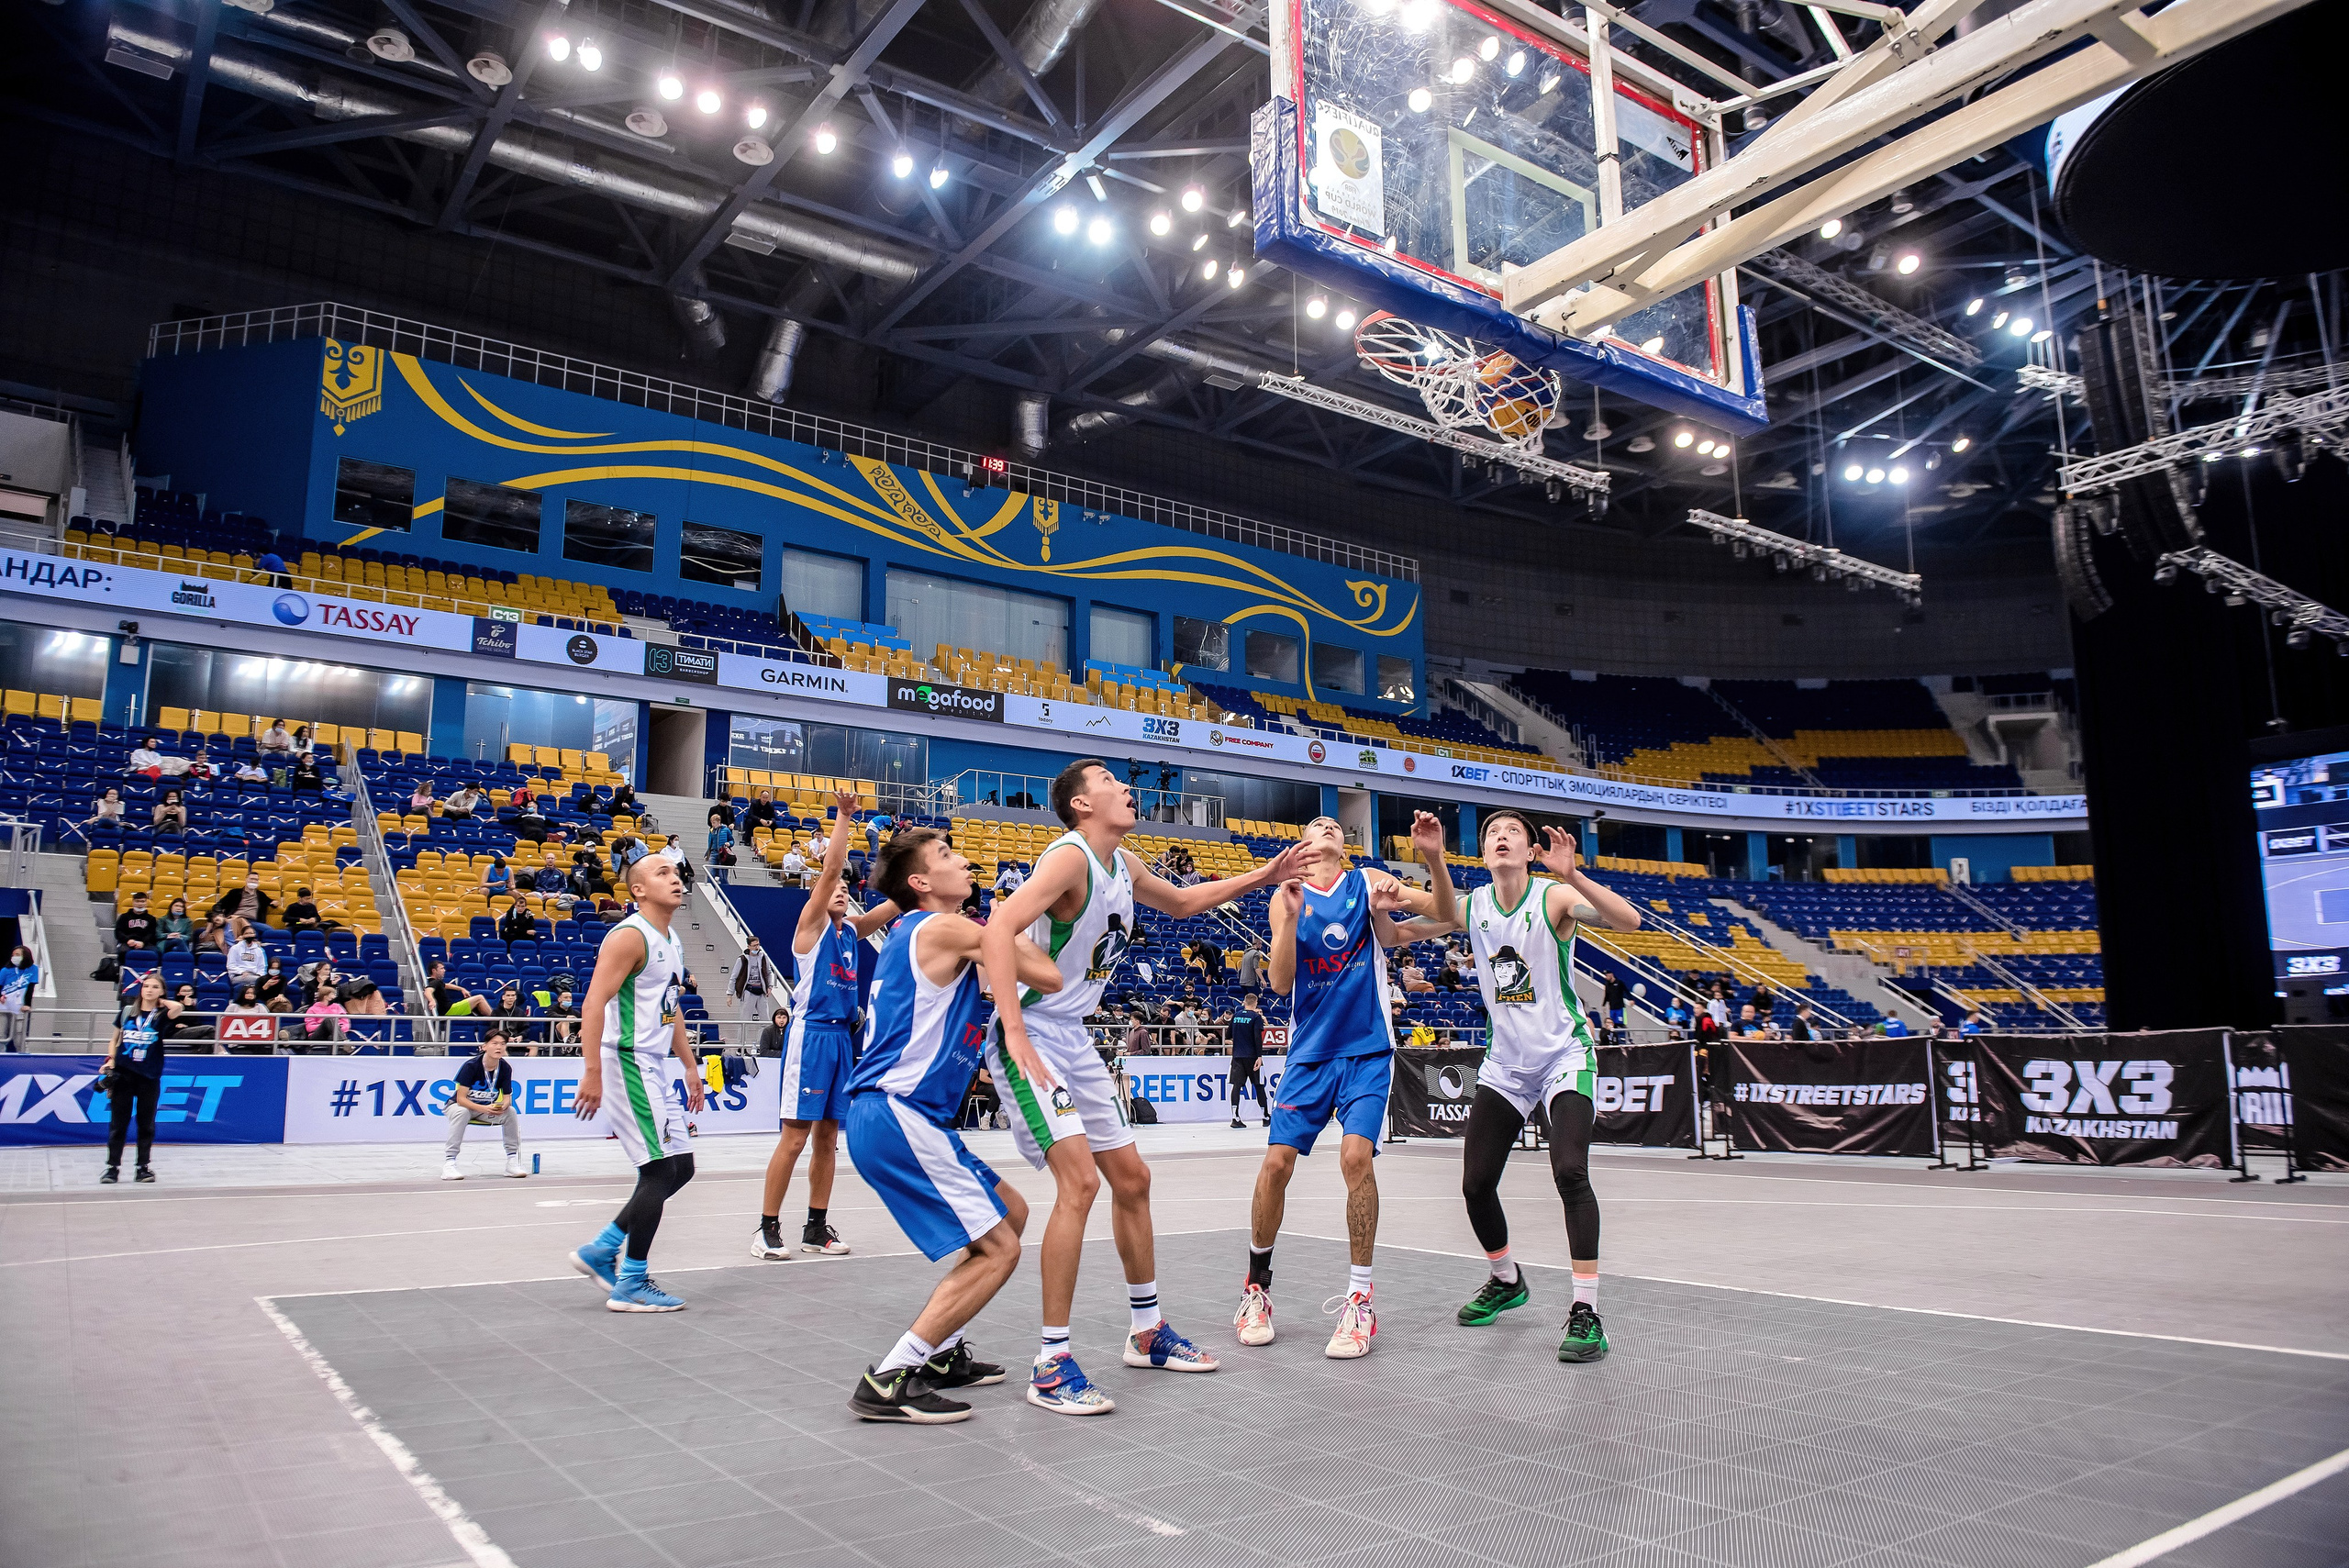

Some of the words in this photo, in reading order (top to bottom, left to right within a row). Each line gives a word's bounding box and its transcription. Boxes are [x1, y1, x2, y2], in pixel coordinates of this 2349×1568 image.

[983, 457, 1004, 472] 11:39
[0, 557, 112, 592] НДАР:
[172, 591, 216, 608] GORILLA
[318, 604, 421, 636] TASSAY
[492, 609, 519, 622] C13
[476, 637, 514, 649] Tchibo
[761, 669, 844, 693] GARMIN
[897, 686, 996, 712] megafood
[942, 706, 993, 718] healthy
[1142, 717, 1180, 736] 3X3
[1142, 733, 1180, 744] KAZAKHSTAN
[1224, 736, 1241, 744] FREE
[1241, 738, 1274, 749] COMPANY
[1451, 765, 1490, 782] 1XBET
[223, 1018, 273, 1039] A4
[1233, 1017, 1252, 1025] STAFF
[1263, 1030, 1286, 1044] A3
[1733, 1082, 1927, 1106] #1XSTREETSTARS
[2020, 1060, 2174, 1115] 3X3
[1427, 1104, 1473, 1121] TASSA
[2024, 1116, 2178, 1140] KAZAKHSTAN
